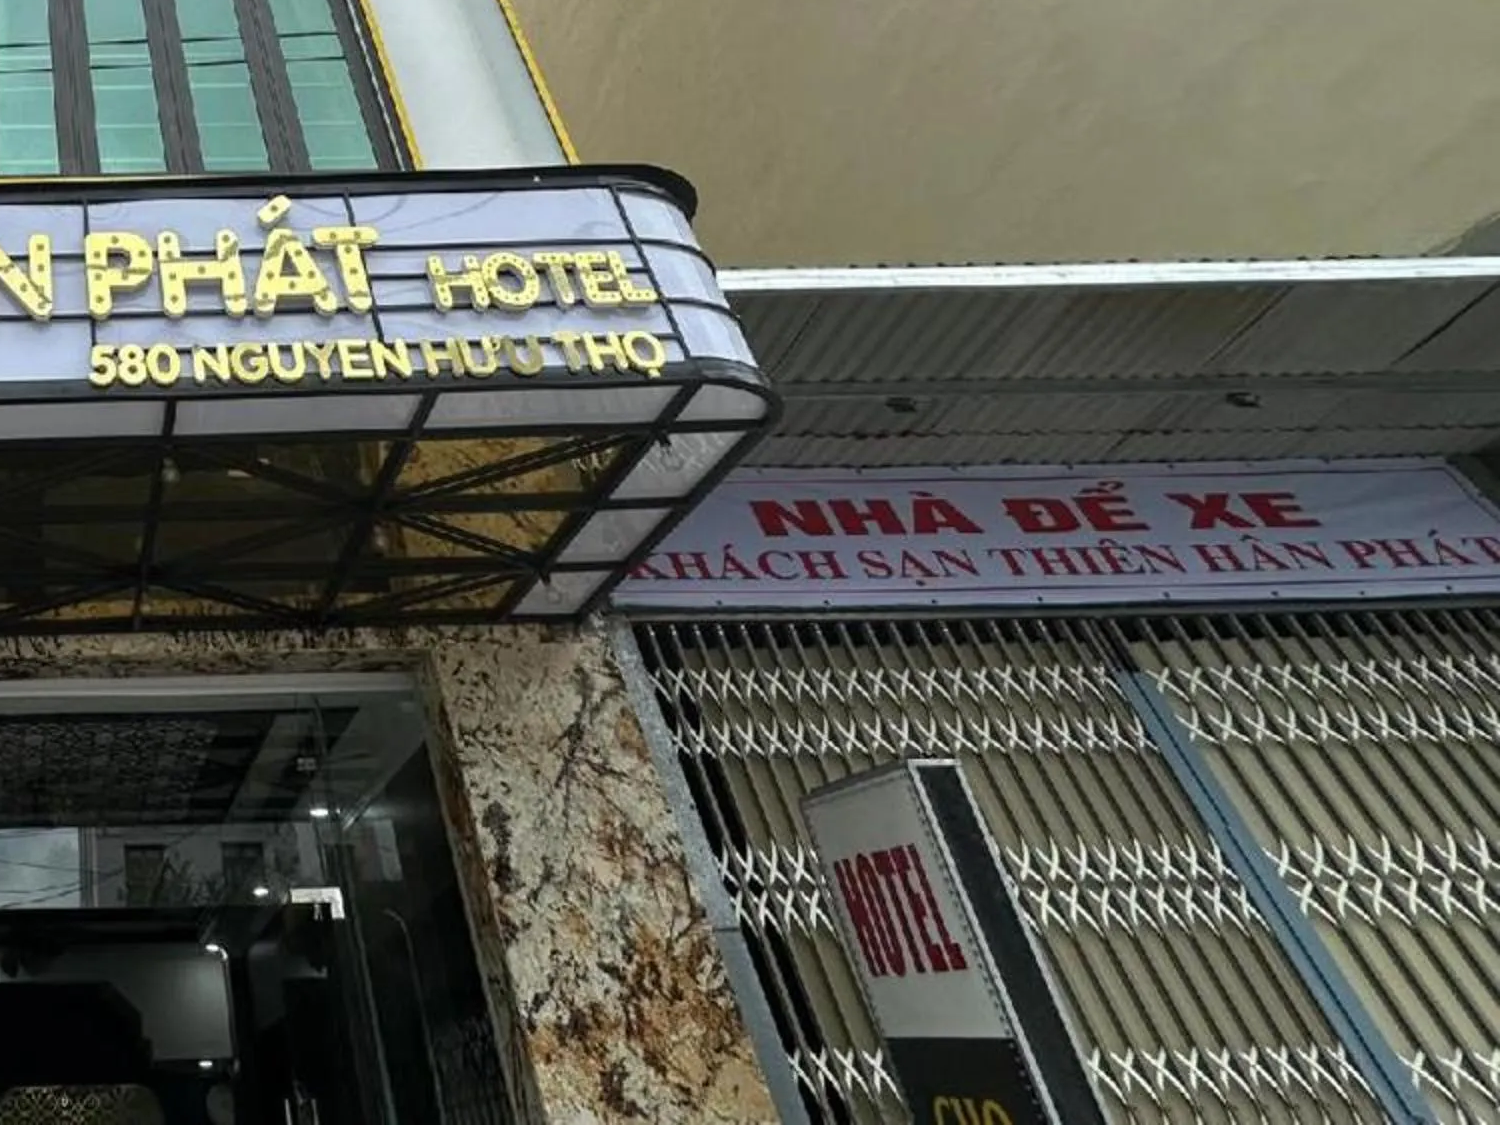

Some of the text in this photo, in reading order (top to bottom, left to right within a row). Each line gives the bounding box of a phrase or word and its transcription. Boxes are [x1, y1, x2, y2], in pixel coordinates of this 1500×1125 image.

[84, 194, 380, 321] PHÁT
[426, 249, 661, 313] HOTEL
[89, 343, 183, 387] 580
[192, 336, 413, 384] NGUYEN
[552, 329, 668, 380] THỌ
[748, 479, 1324, 538] NHÀ ĐỂ XE
[986, 537, 1189, 577] THIÊN
[833, 842, 969, 978] HOTEL
